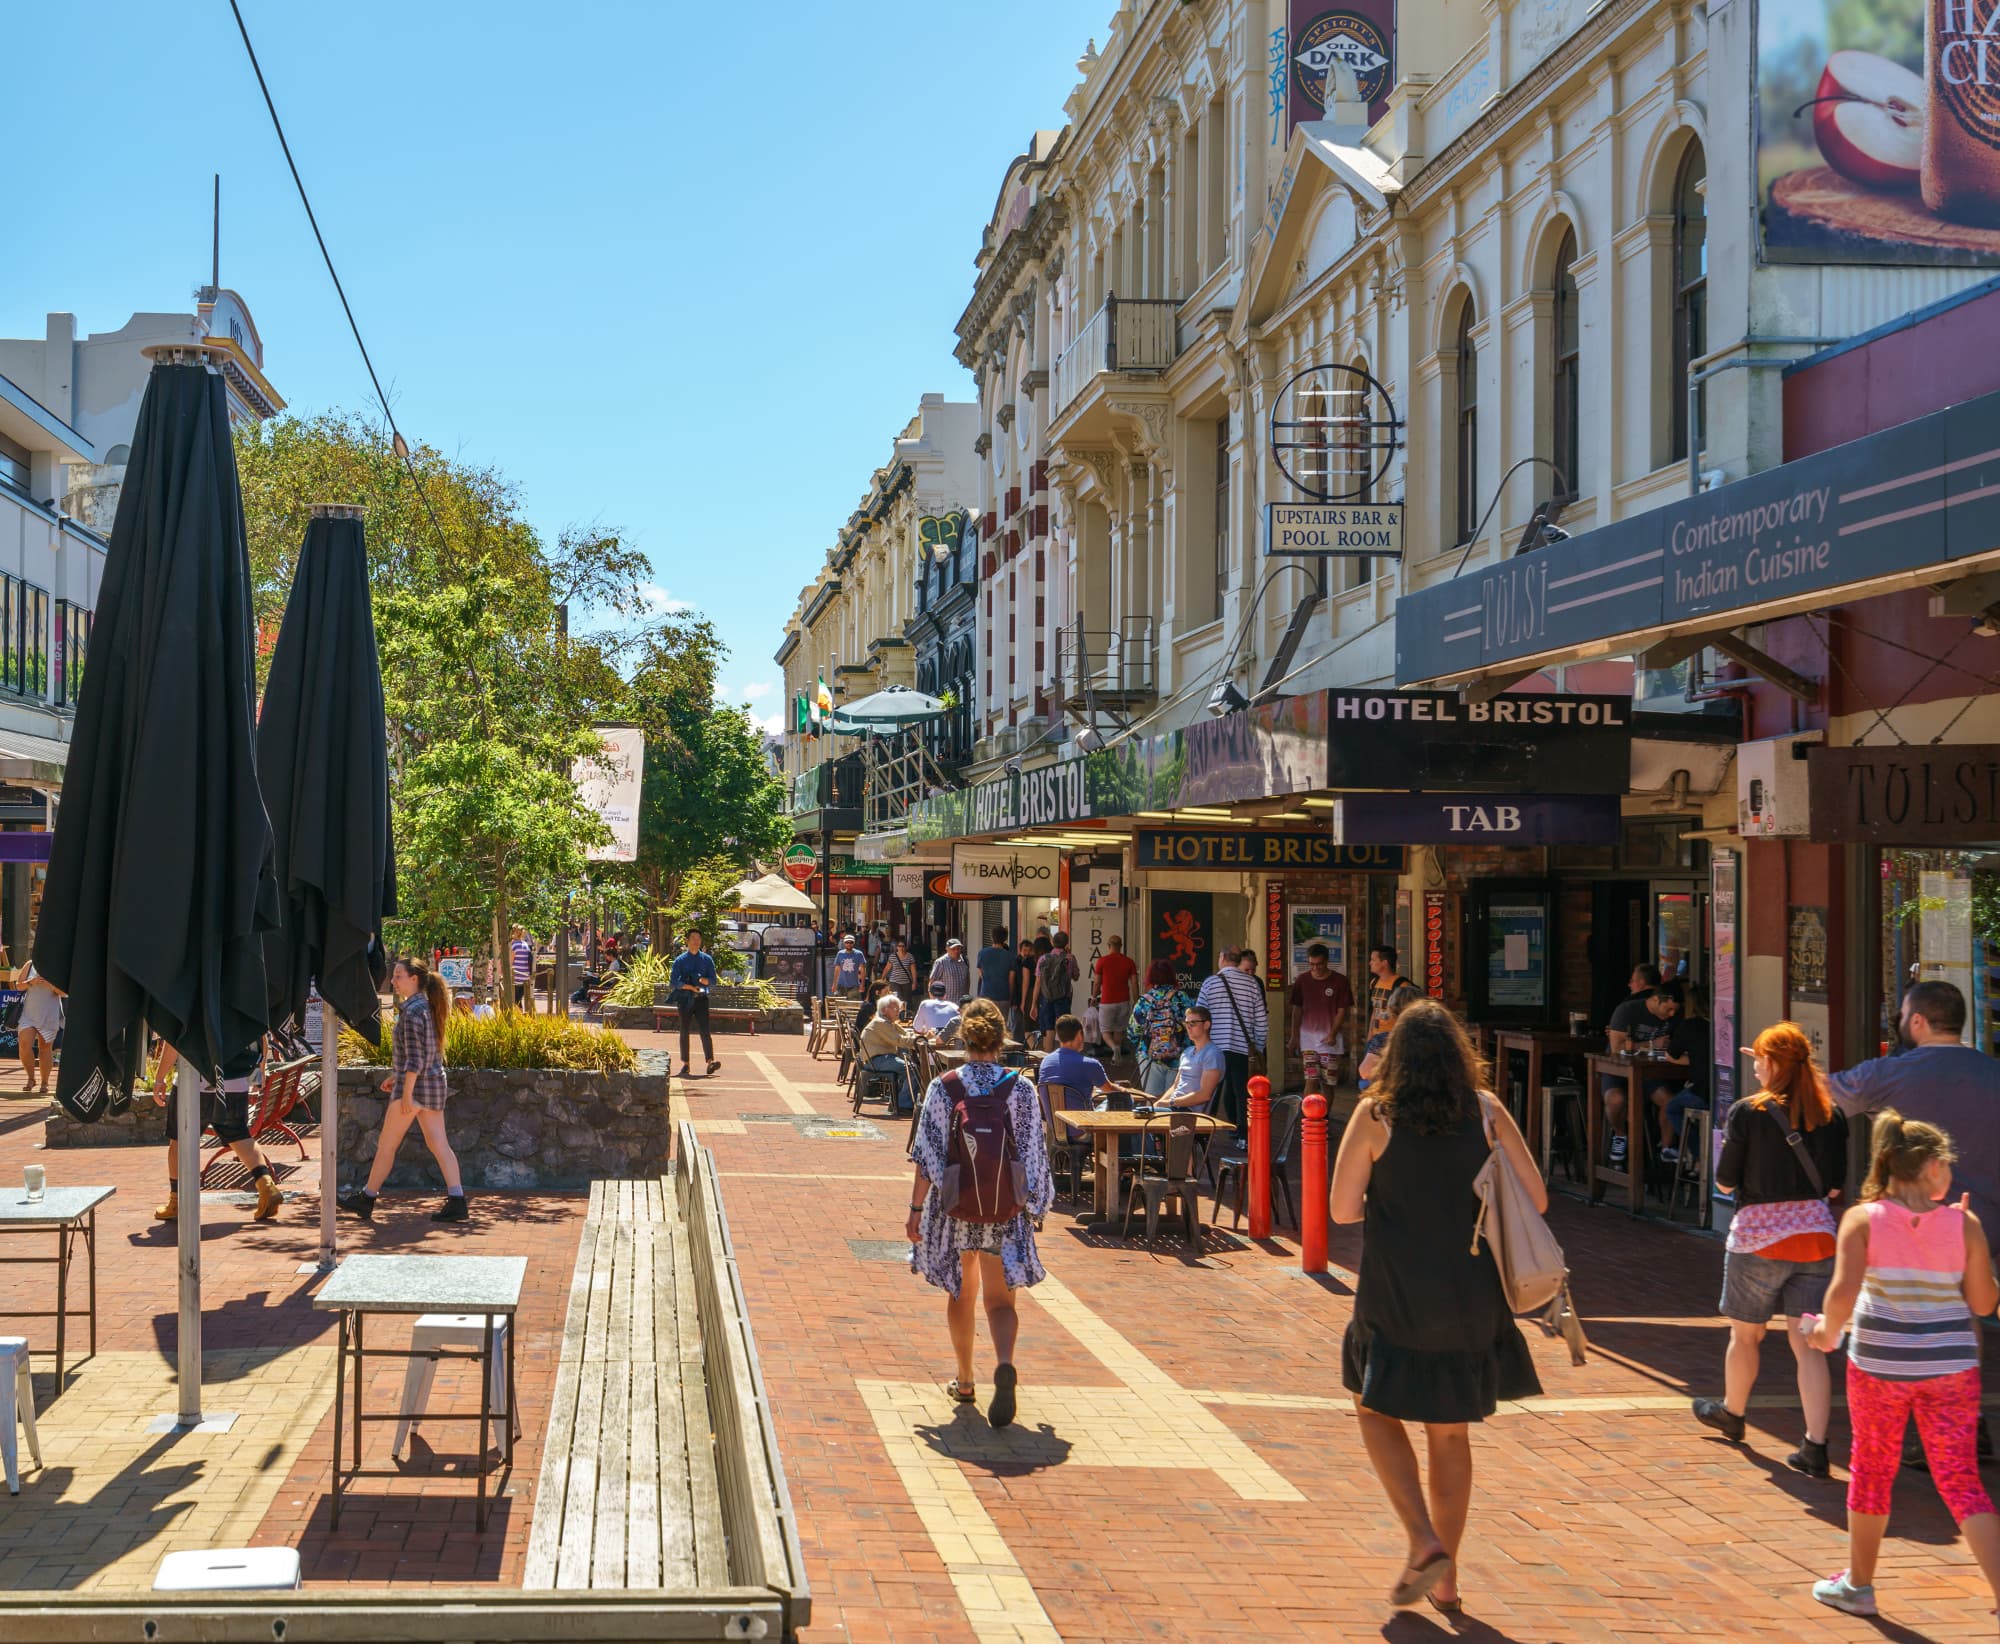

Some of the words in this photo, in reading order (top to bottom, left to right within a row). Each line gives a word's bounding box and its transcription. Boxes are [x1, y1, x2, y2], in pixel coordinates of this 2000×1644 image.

[1308, 20, 1377, 45] SPEIGHT'S
[1941, 39, 2000, 85] CI
[1275, 510, 1346, 525] UPSTAIRS
[1352, 511, 1383, 525] BAR
[1387, 512, 1398, 525] &
[1672, 486, 1831, 556] Contemporary
[1282, 530, 1330, 546] POOL
[1338, 531, 1391, 547] ROOM
[1675, 559, 1738, 604] Indian
[1745, 536, 1830, 586] Cuisine
[1336, 697, 1456, 721] HOTEL
[1468, 701, 1623, 725] BRISTOL
[975, 778, 1016, 831] HOTEL
[1019, 760, 1091, 825] BRISTOL
[1442, 806, 1522, 832] TAB
[1153, 836, 1254, 862] HOTEL
[1263, 838, 1390, 864] BRISTOL
[979, 863, 1051, 880] BAMBOO
[1269, 893, 1281, 970] POOLROOM
[1427, 906, 1443, 1000] POOLROOM
[1791, 951, 1825, 966] NOW
[1175, 973, 1192, 981] ION
